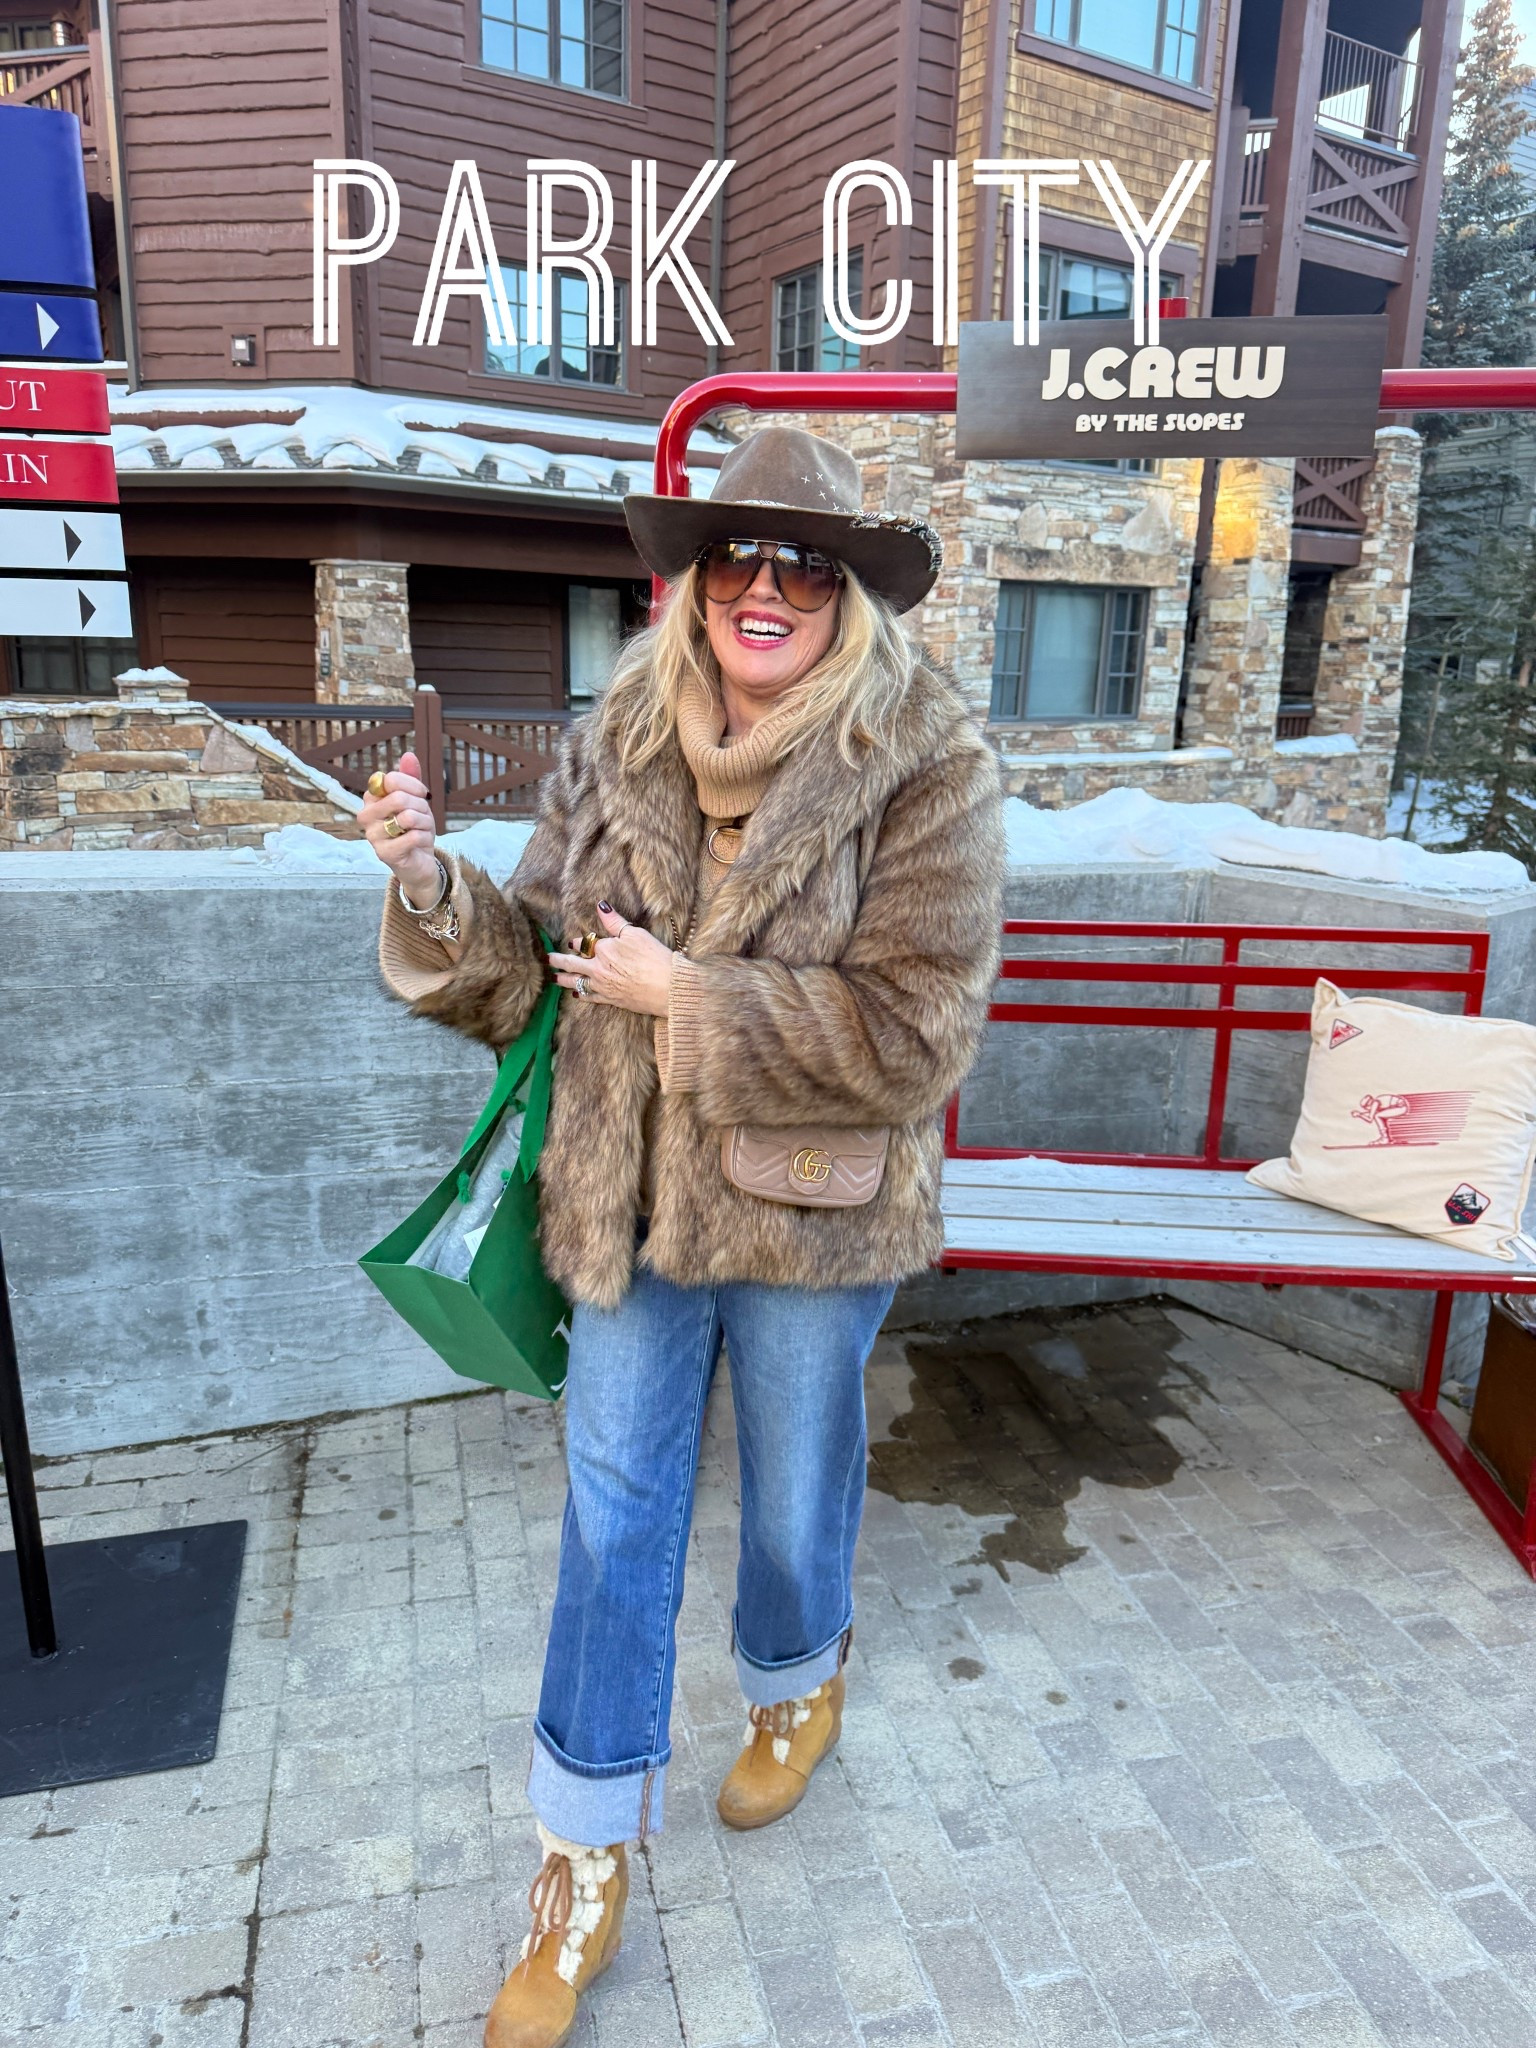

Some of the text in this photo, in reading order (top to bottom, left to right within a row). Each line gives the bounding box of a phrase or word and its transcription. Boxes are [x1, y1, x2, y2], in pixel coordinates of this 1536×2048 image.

[1041, 345, 1286, 401] J.CREW
[1075, 412, 1246, 433] BY THE SLOPES
[0, 453, 49, 484] IN
